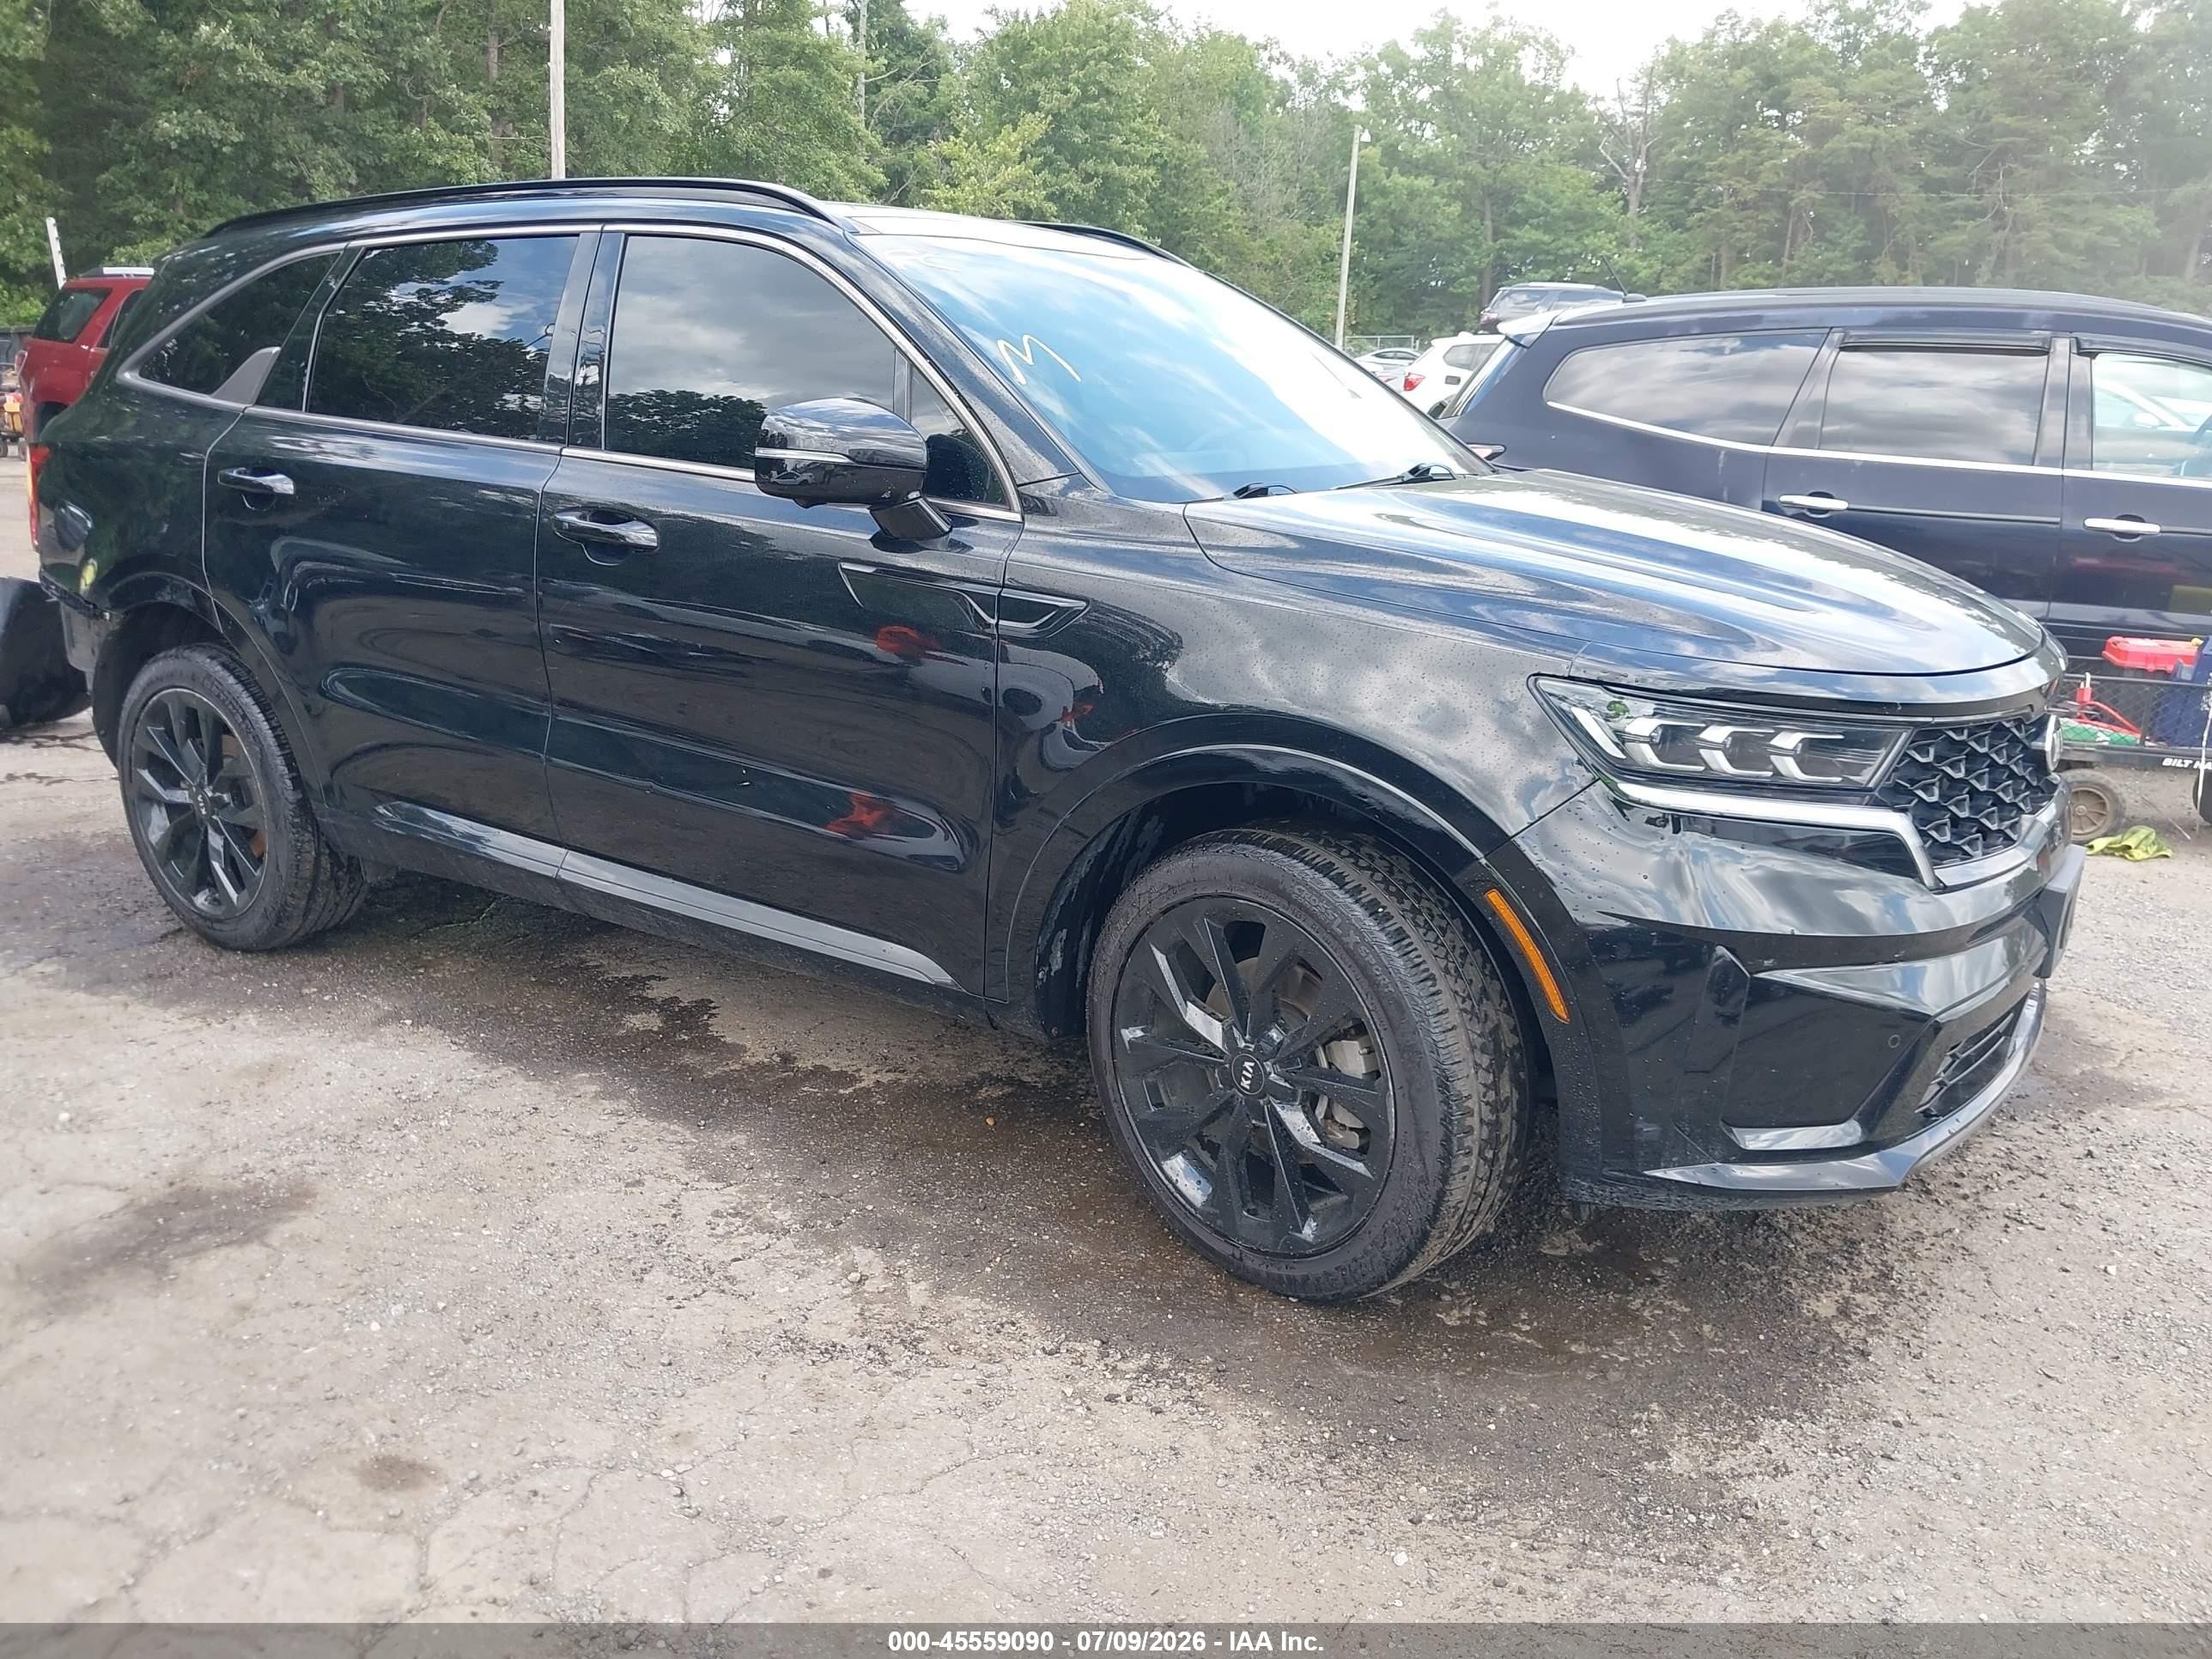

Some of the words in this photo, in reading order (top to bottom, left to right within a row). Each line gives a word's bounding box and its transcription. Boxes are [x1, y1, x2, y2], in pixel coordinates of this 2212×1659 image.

[997, 334, 1082, 386] M
[2161, 757, 2193, 768] BILT
[1241, 1061, 1255, 1090] KIA
